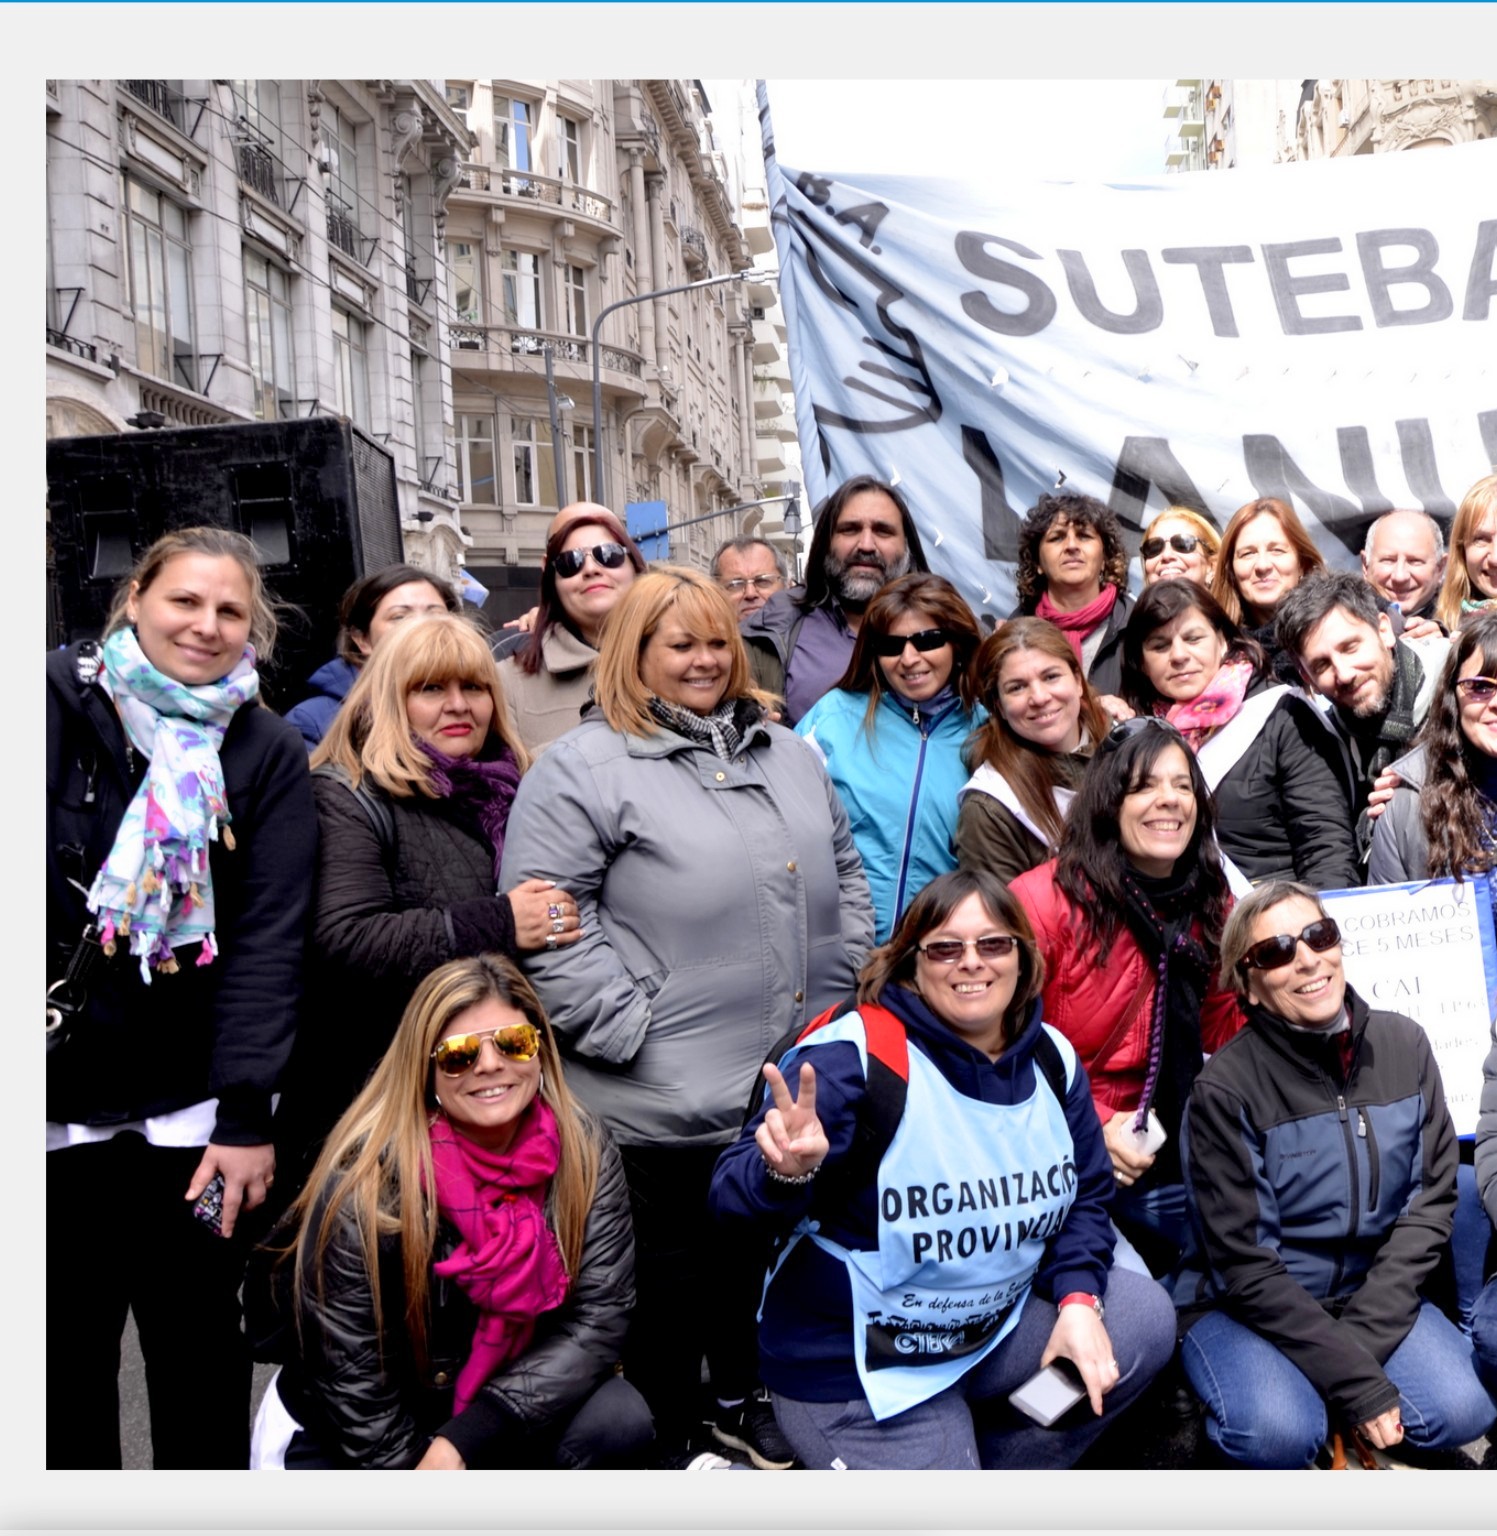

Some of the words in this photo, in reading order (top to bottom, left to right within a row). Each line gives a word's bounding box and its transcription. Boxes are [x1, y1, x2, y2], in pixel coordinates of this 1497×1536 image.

[1344, 902, 1471, 933] COBRAMOS
[1377, 938, 1389, 952] 5
[1396, 926, 1474, 951] MESES
[881, 1155, 1078, 1222] ORGANIZACIÓ
[913, 1205, 1069, 1264] PROVINCIA
[902, 1294, 922, 1308] En
[929, 1298, 975, 1313] defensa
